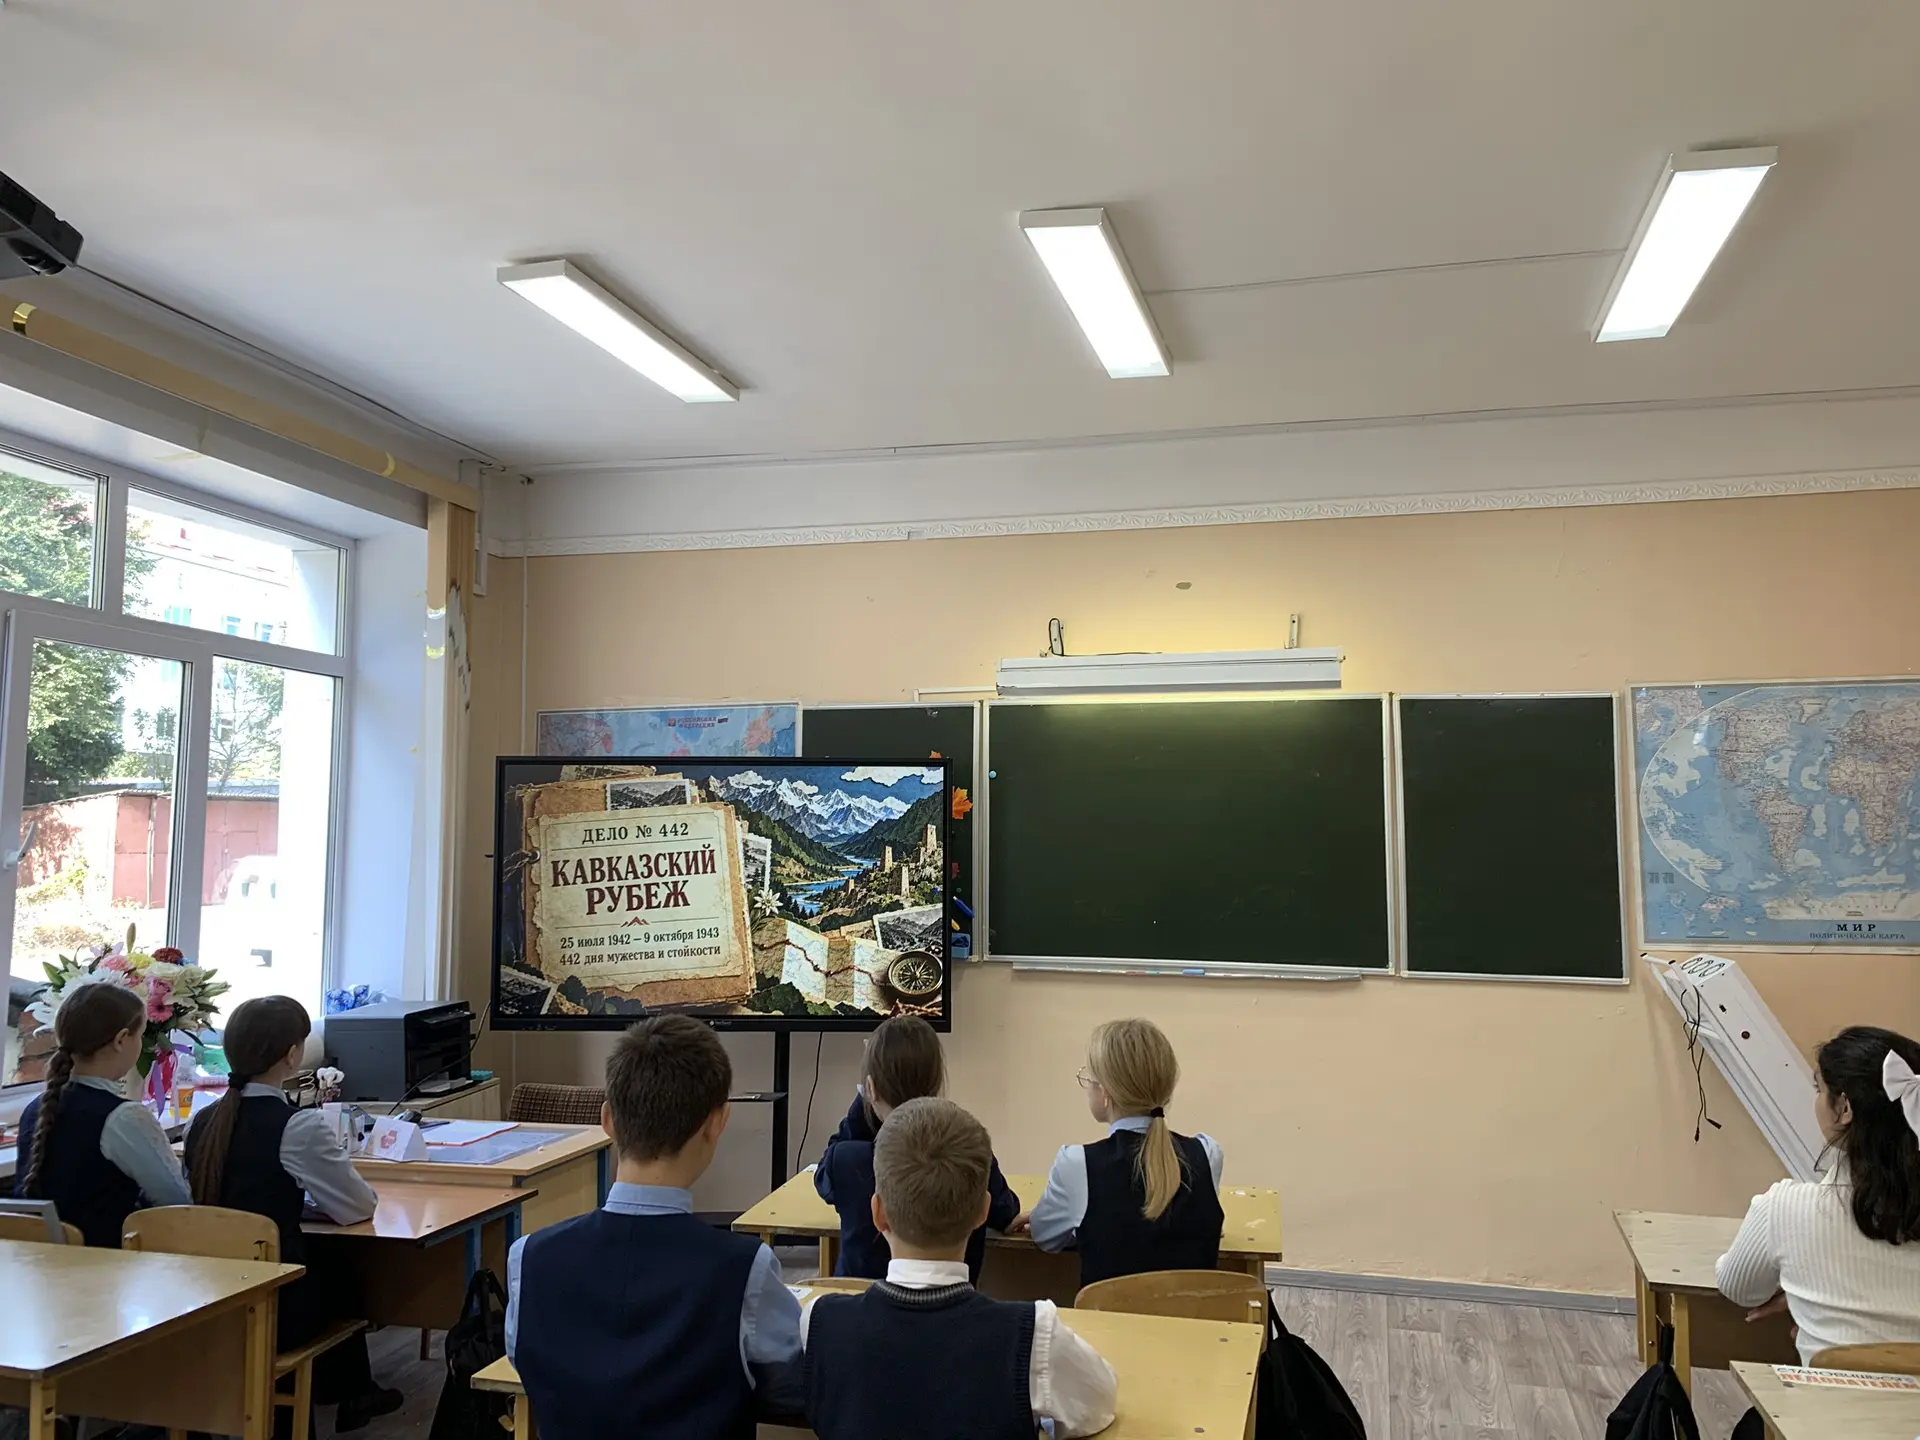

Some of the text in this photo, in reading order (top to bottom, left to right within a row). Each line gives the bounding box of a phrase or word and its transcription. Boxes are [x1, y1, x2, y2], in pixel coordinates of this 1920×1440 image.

[582, 822, 689, 845] ДЕЛО № 442
[551, 843, 717, 888] КАВКАЗСКИЙ
[585, 880, 691, 916] РУБЕЖ
[560, 936, 574, 949] 25
[577, 936, 605, 948] июля
[608, 934, 631, 946] 1942
[644, 932, 651, 944] 9
[653, 929, 694, 944] октября
[696, 927, 720, 940] 1943
[1809, 932, 1877, 940] ПОЛИТИЧЕСКАЯ
[1836, 923, 1876, 932] МИР
[559, 945, 721, 966] 442 дня мужества и стойкости
